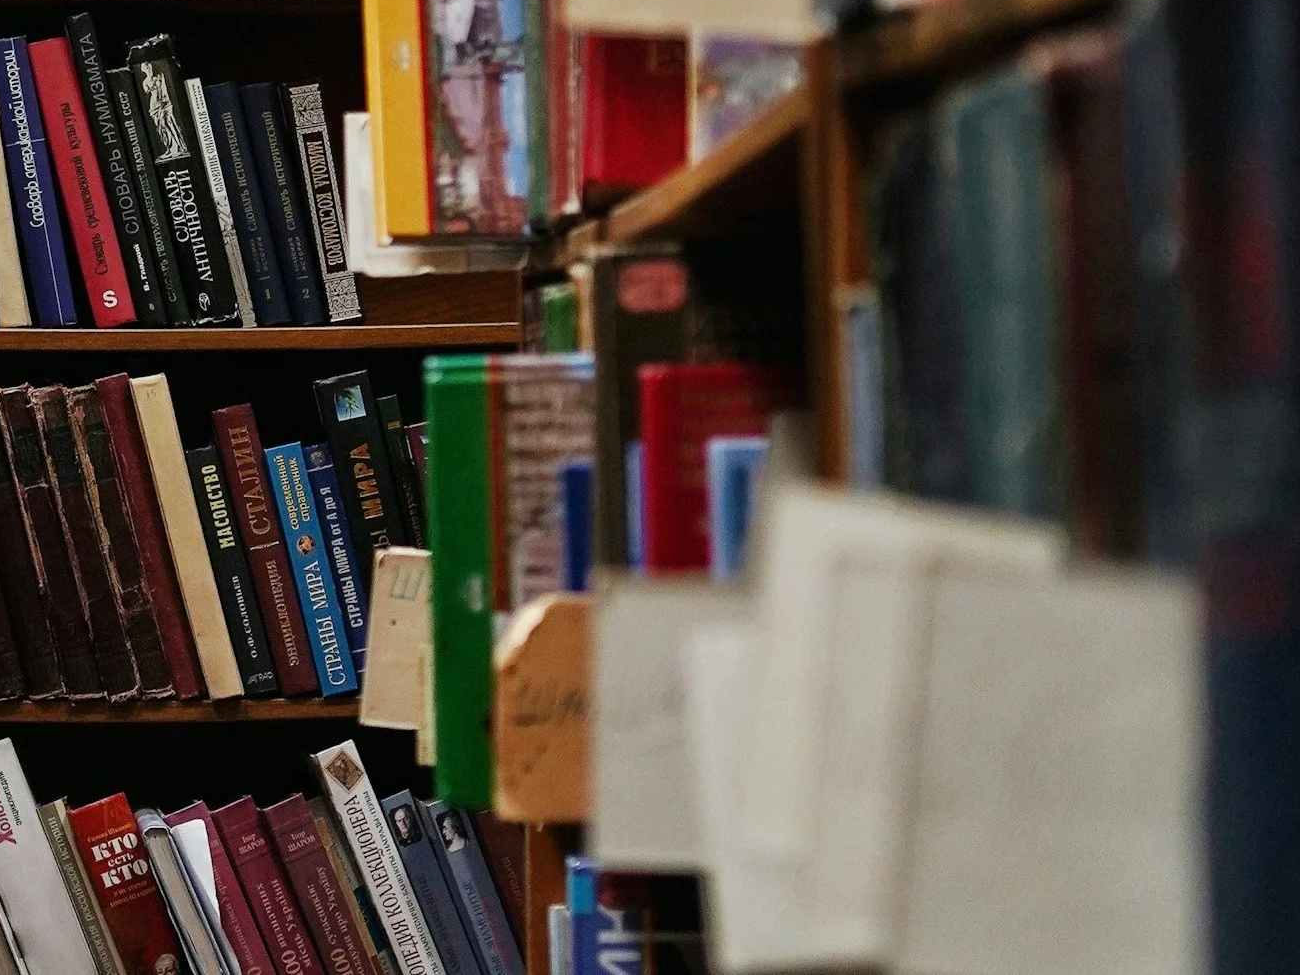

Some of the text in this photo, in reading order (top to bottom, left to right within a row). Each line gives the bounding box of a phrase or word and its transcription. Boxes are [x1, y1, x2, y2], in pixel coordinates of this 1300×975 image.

[3, 50, 45, 228] Словарь американской истории
[60, 101, 109, 276] Словарь средневековой культуры
[80, 32, 140, 235] СЛОВАРЬ НУМИЗМАТА
[220, 111, 258, 232] СЛОВАРЬ ИСТОРИЧЕСКИЙ
[262, 111, 296, 232] СЛОВАРЬ ИСТОРИЧЕСКИЙ
[163, 170, 190, 243] СЛОВАРЬ
[176, 168, 214, 282] АНТИЧНОСТИ
[306, 140, 344, 265] МИКОЛА КОСТОМАРОВ
[102, 289, 118, 308] S
[200, 464, 236, 549] МАСОНСТВО
[273, 454, 300, 531] современный
[288, 457, 311, 522] справочник
[349, 442, 384, 520] МИРА
[228, 424, 300, 666] ЭНЦИКЛОПЕДИЯ СТАЛИН
[319, 486, 364, 628] СТРАНЫ МИРА от А до Я
[303, 559, 346, 686] СТРАНЫ МИРА
[91, 832, 138, 863] КТО
[100, 858, 149, 889] КТО
[107, 853, 134, 867] есть
[343, 794, 403, 918] КОЛЛЕКЦИОНЕРА
[271, 878, 297, 932] України
